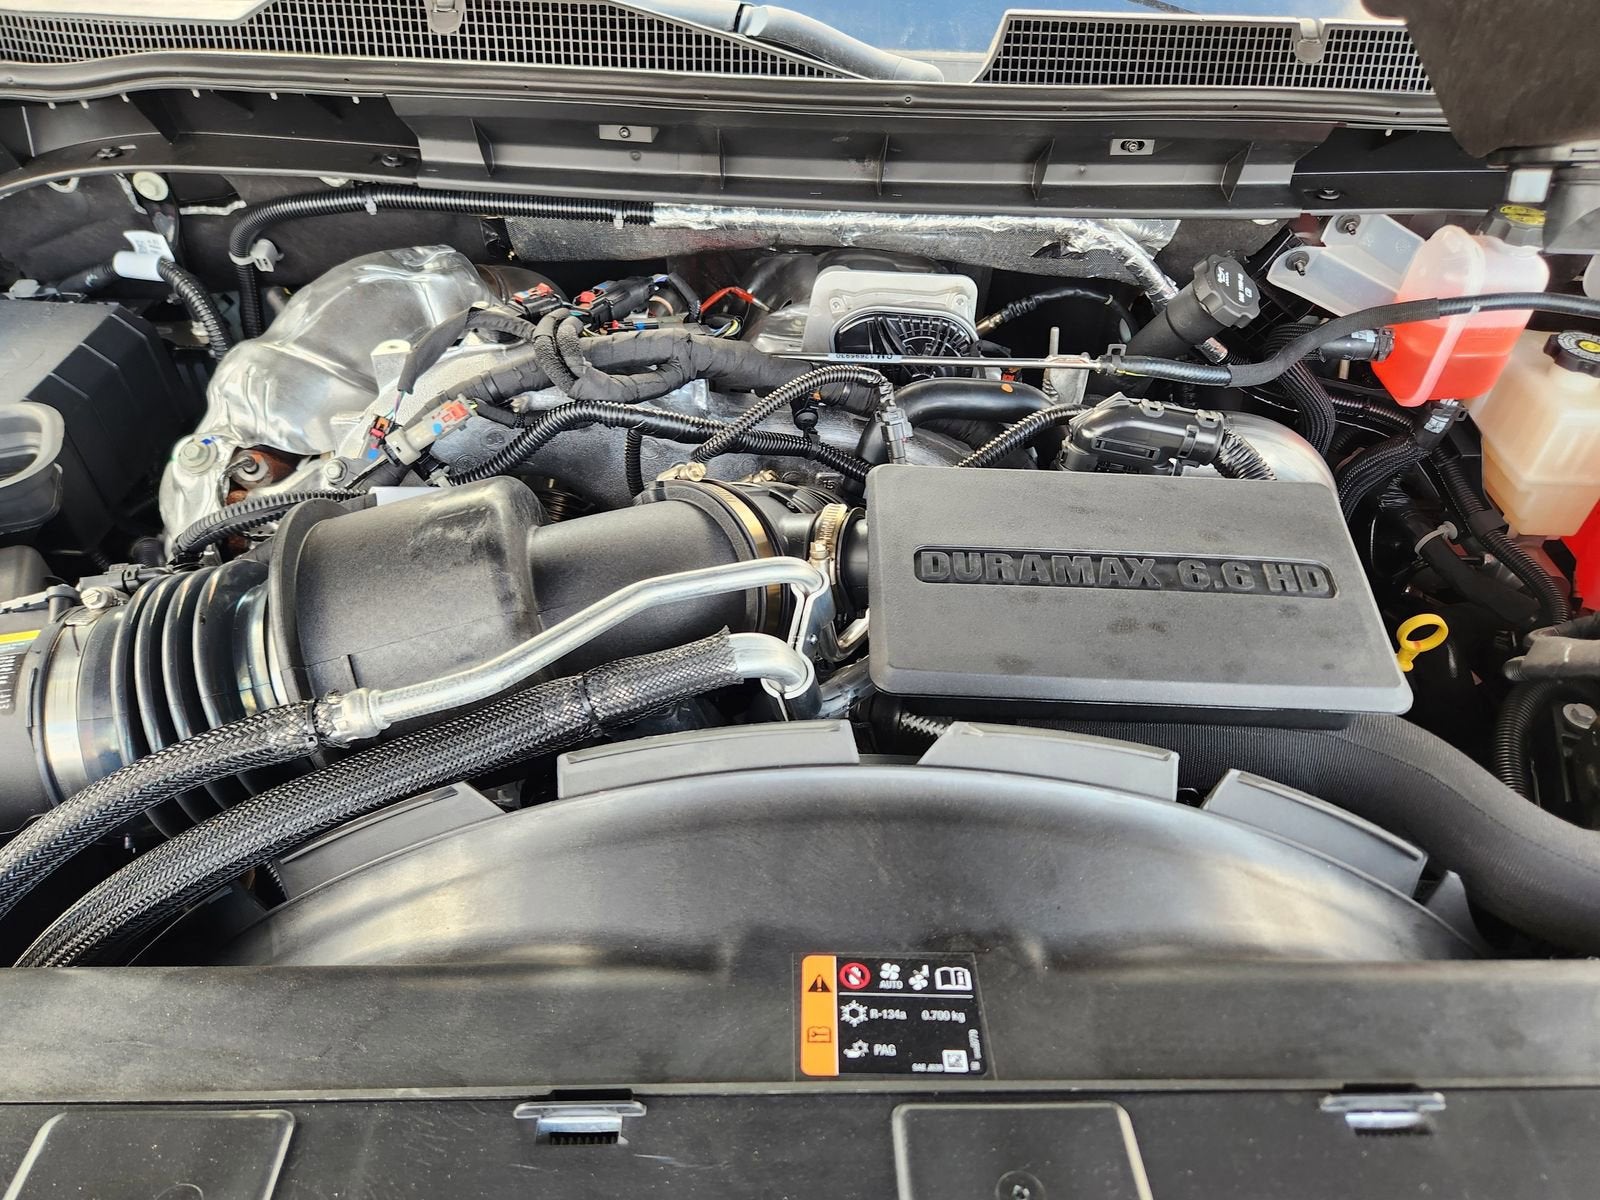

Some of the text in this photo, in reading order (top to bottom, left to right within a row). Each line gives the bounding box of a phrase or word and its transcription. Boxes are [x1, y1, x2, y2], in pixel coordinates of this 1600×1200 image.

[920, 551, 1331, 594] DURAMAX 6.6 HD
[878, 980, 904, 990] AUTO
[869, 1008, 966, 1024] R-134a 0.700 kg
[873, 1043, 898, 1057] PAG
